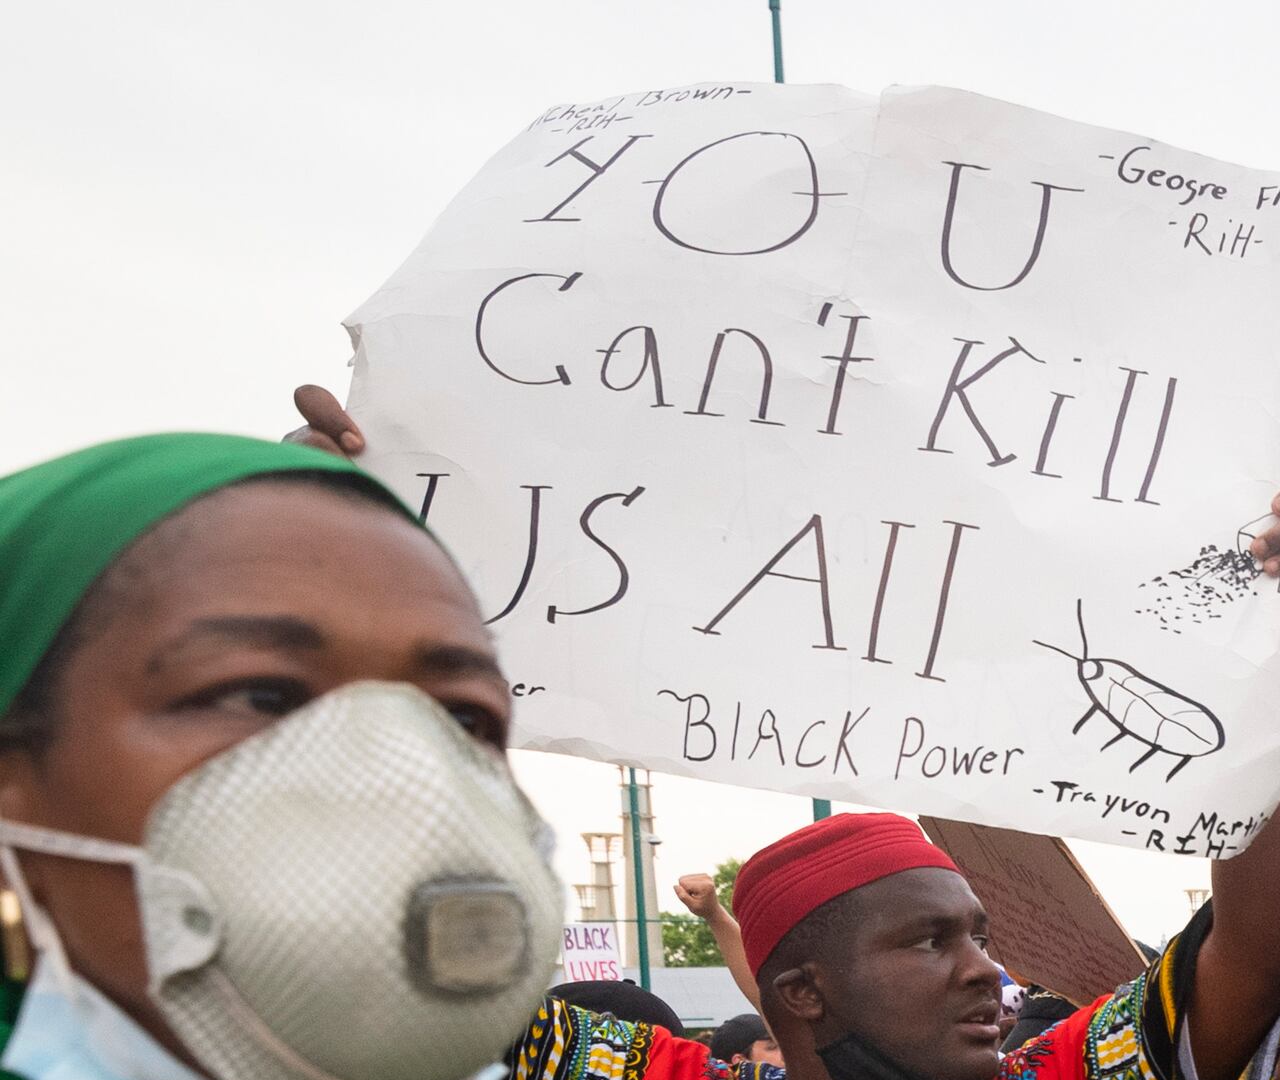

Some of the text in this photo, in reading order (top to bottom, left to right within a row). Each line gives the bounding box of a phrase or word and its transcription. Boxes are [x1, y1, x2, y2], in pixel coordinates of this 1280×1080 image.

[476, 272, 1178, 506] Can't Kill
[895, 717, 1024, 779] Power
[563, 927, 613, 950] BLACK
[569, 960, 619, 981] LIVES
